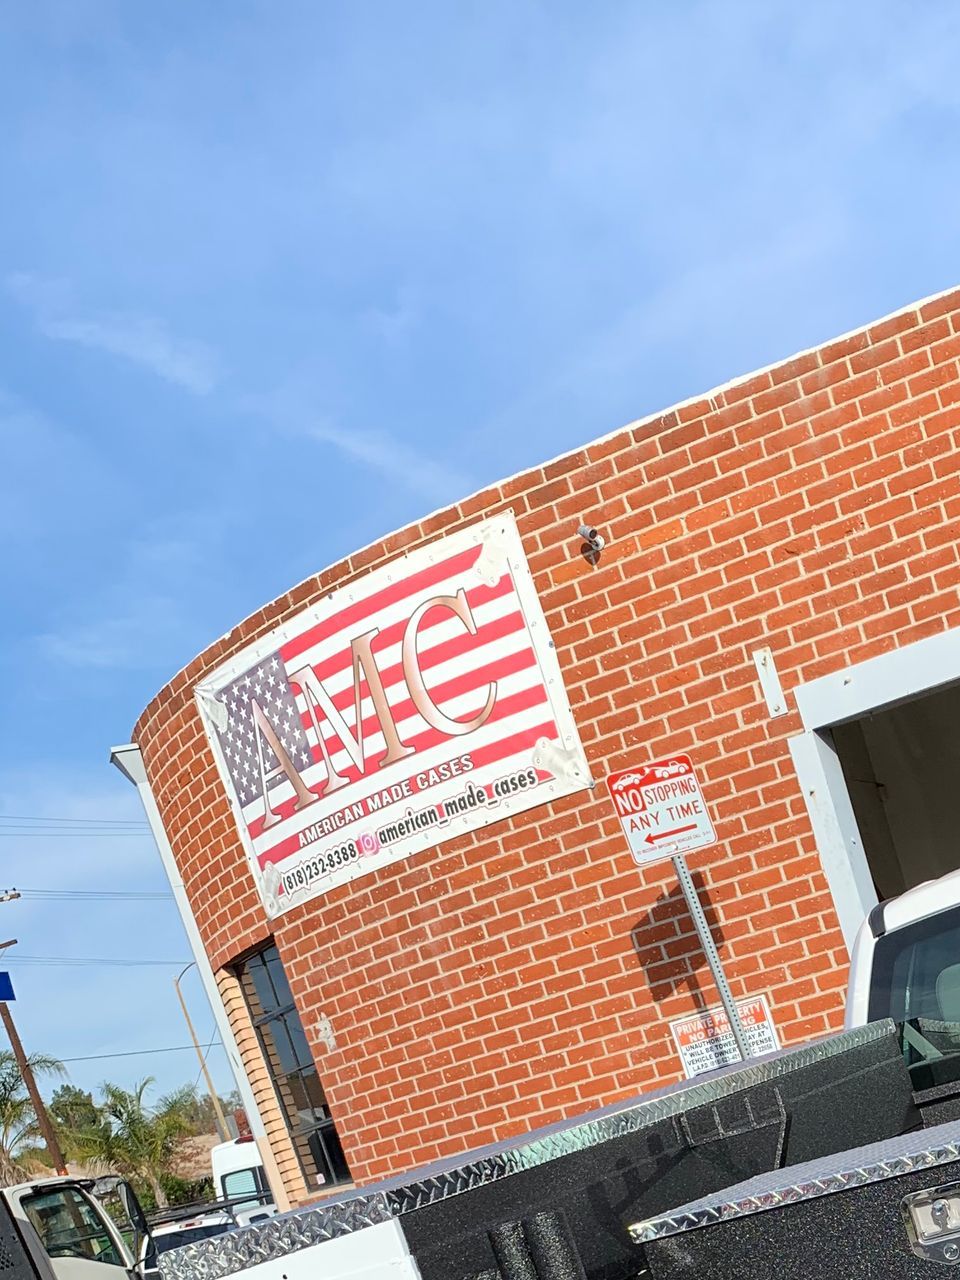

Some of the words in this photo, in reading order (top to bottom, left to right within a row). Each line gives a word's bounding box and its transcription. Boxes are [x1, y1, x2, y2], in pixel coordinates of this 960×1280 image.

[251, 587, 498, 829] AMC
[298, 801, 365, 849] AMERICAN
[365, 778, 413, 813] MADE
[416, 753, 475, 790] CASES
[615, 789, 643, 815] NO
[644, 777, 697, 806] STOPPING
[282, 842, 357, 896] (818)232-8388
[378, 769, 537, 845] american_made_cases
[630, 811, 660, 833] ANY
[666, 799, 702, 822] TIME
[677, 1016, 714, 1036] PRIVATE
[714, 1001, 761, 1026] PRERTY
[688, 1030, 706, 1043] NO
[707, 1015, 756, 1037] PARNG
[685, 1032, 734, 1052] UNAUTHORIZED
[687, 1053, 714, 1066] VEHICLE
[714, 1047, 737, 1058] OWNER
[749, 1036, 773, 1048] PENSE
[689, 1048, 705, 1058] WILL
[705, 1045, 715, 1054] BE
[714, 1039, 737, 1051] TOWED
